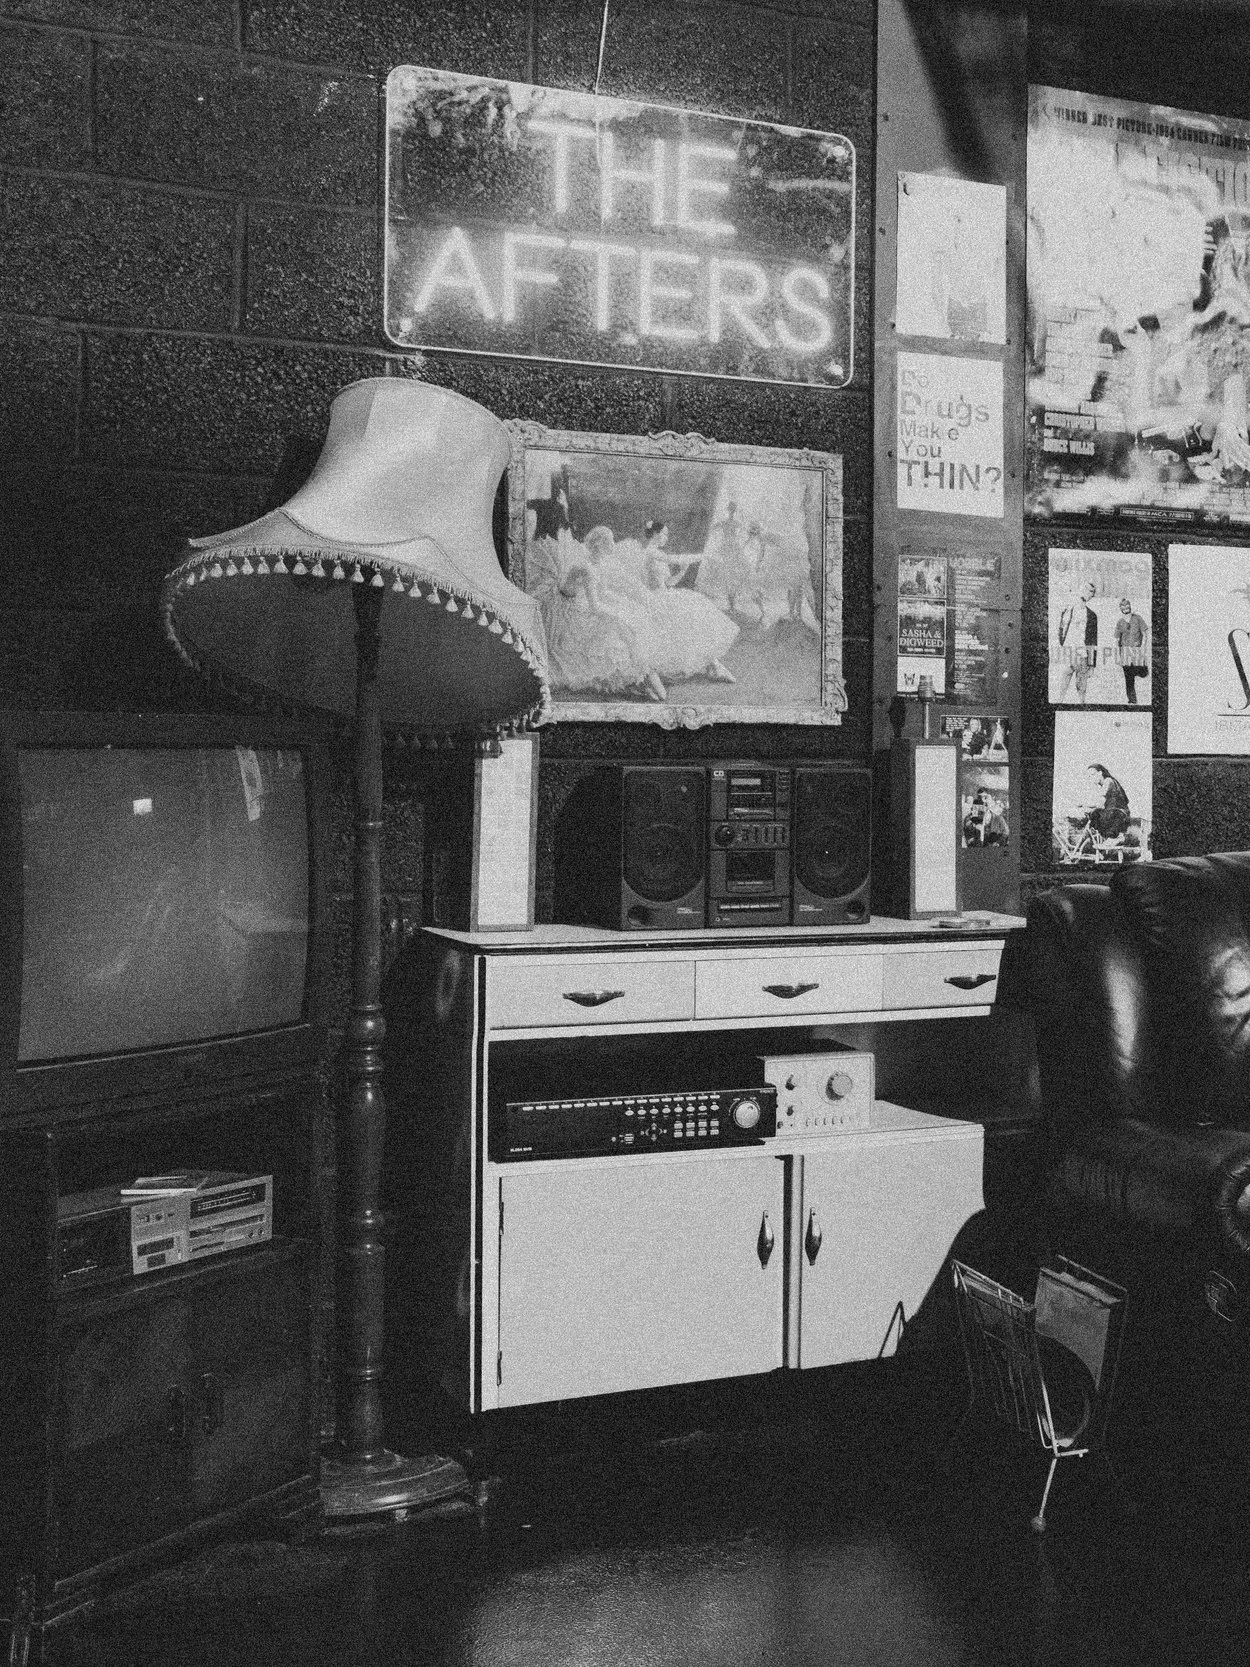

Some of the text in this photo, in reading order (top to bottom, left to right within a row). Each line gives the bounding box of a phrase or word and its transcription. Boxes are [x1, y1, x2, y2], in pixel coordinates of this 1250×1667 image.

[527, 119, 739, 236] THE
[412, 225, 834, 353] AFTERS
[902, 370, 929, 388] Do
[900, 390, 990, 428] Drugs
[900, 419, 959, 441] Make
[901, 439, 941, 458] You
[900, 459, 1001, 493] THIN?
[899, 637, 944, 648] DIGWEED
[901, 628, 941, 639] SASHA &
